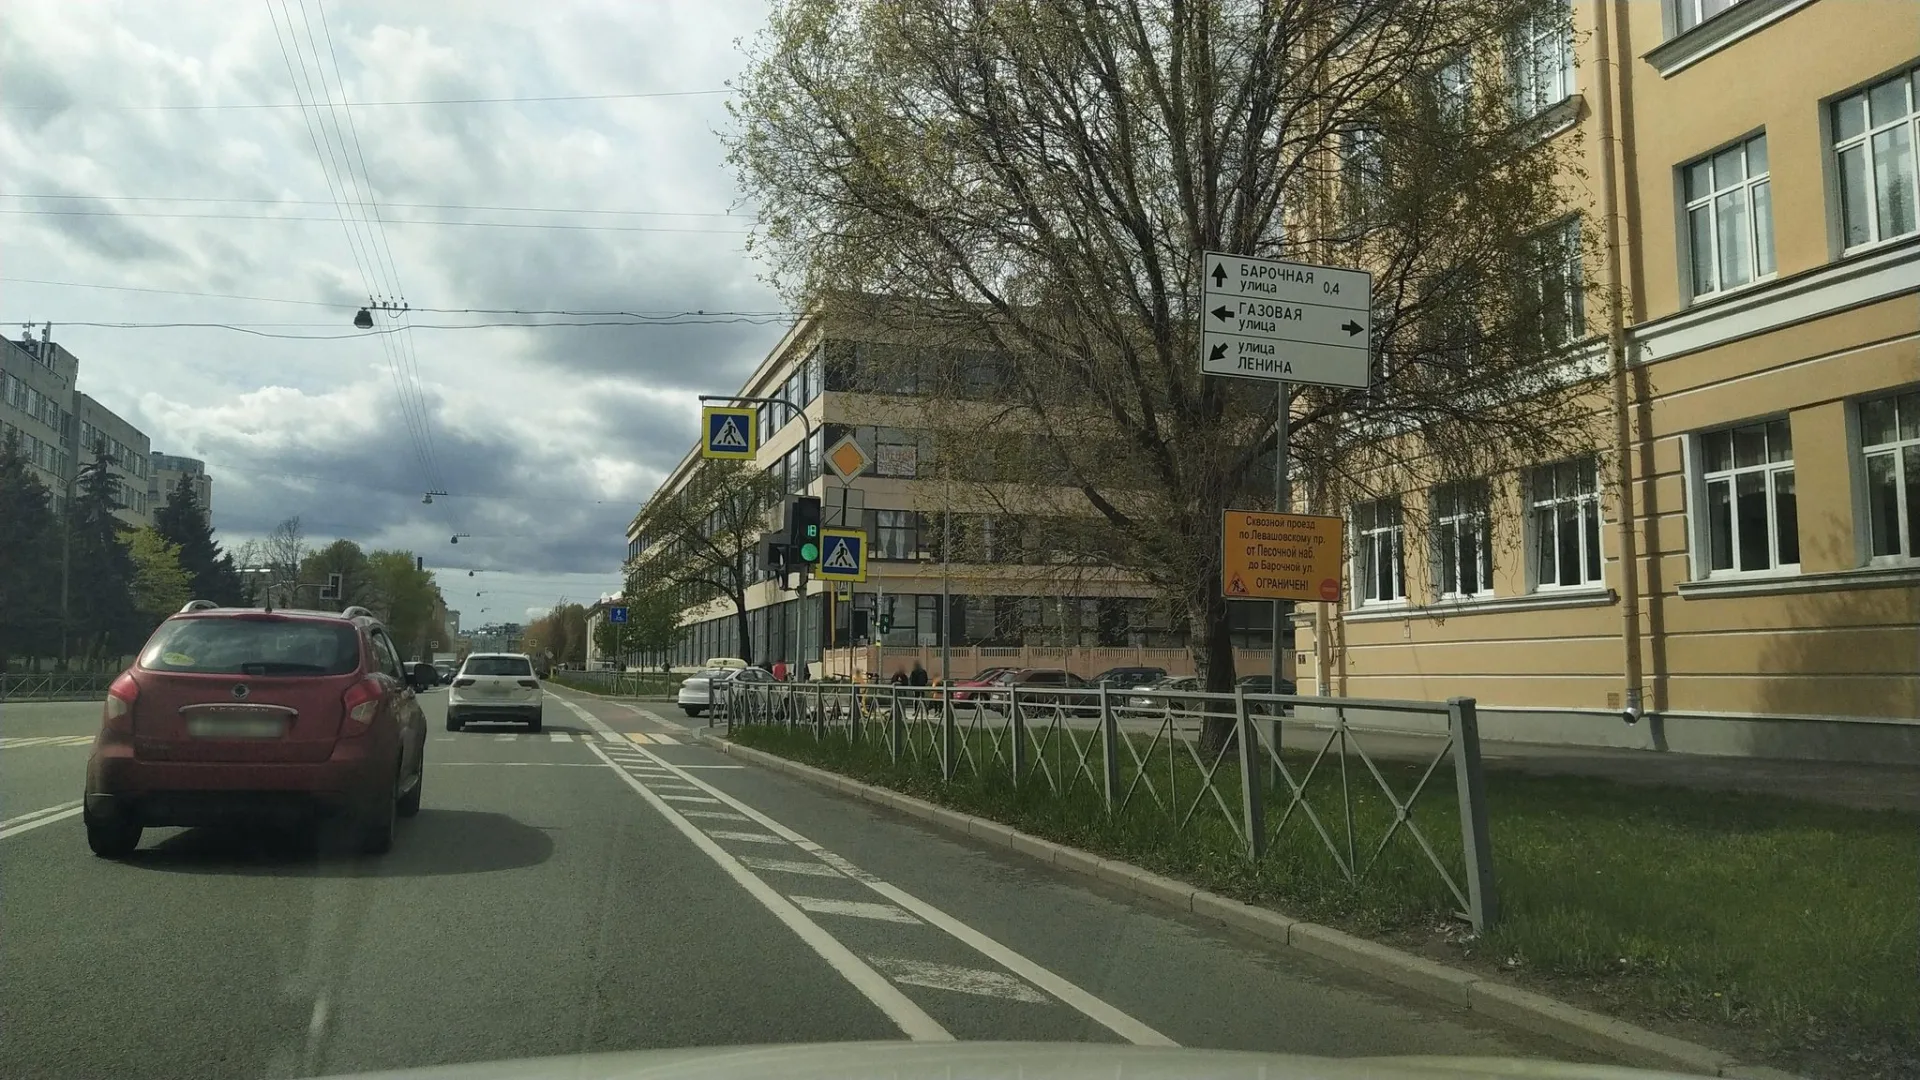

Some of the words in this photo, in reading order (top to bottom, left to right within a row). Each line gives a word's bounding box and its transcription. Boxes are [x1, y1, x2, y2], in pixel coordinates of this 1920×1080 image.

[1240, 264, 1314, 284] БАРОЧНАЯ
[1240, 280, 1277, 293] улица
[1323, 281, 1340, 295] 0,4
[1239, 302, 1302, 321] ГАЗОВАЯ
[1238, 318, 1276, 332] улица
[1238, 341, 1275, 355] улица
[1237, 356, 1292, 374] ЛЕНИНА
[1246, 516, 1284, 527] Сквозной
[1287, 520, 1315, 530] проезд
[1239, 531, 1249, 540] по
[1252, 530, 1311, 545] Левашовскому
[1313, 535, 1326, 545] пр.
[1246, 546, 1255, 556] от
[1257, 544, 1297, 557] Песочной
[1298, 547, 1315, 559] наб.
[1248, 562, 1259, 570] до
[1261, 560, 1300, 573] Барочной
[1256, 577, 1309, 591] ОГРАНИЧЕН!
